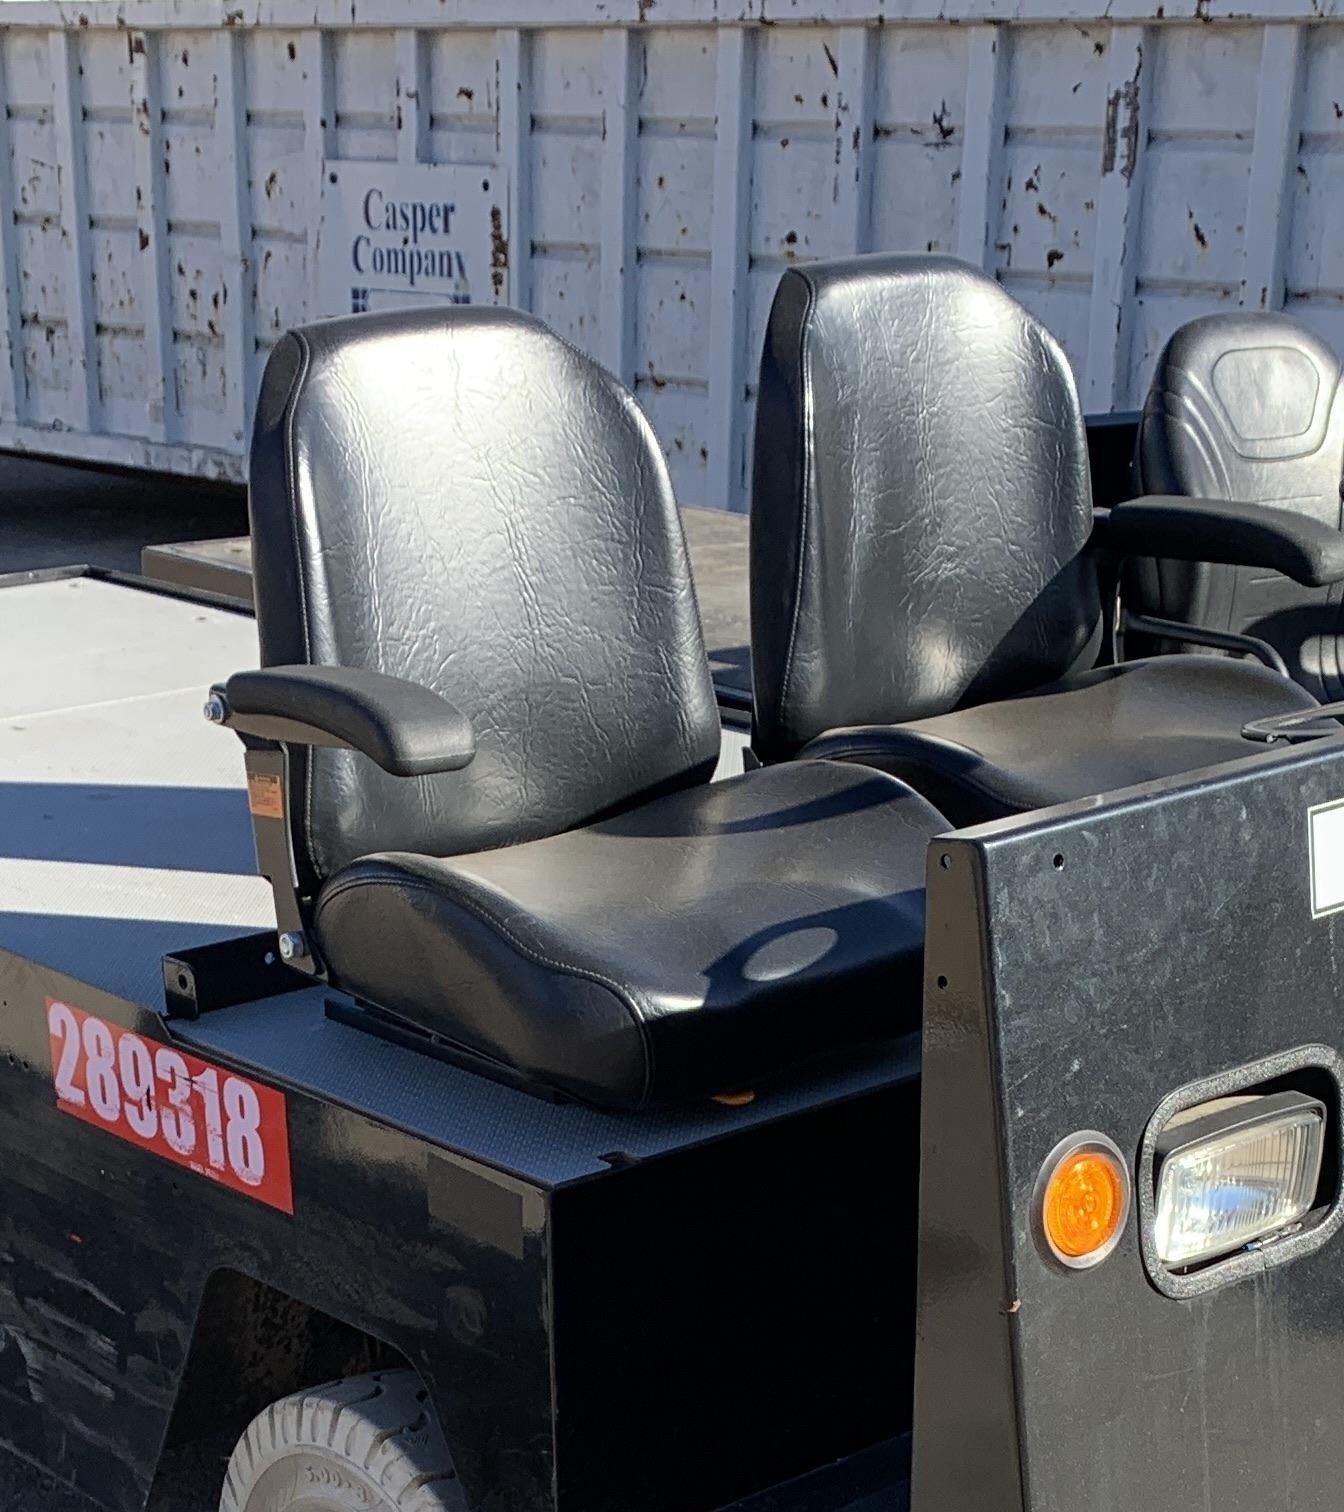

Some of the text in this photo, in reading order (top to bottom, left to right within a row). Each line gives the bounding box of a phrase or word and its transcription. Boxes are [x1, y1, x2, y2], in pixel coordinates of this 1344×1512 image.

[362, 188, 456, 243] Casper
[352, 234, 472, 291] Company
[48, 1002, 265, 1187] 289318
